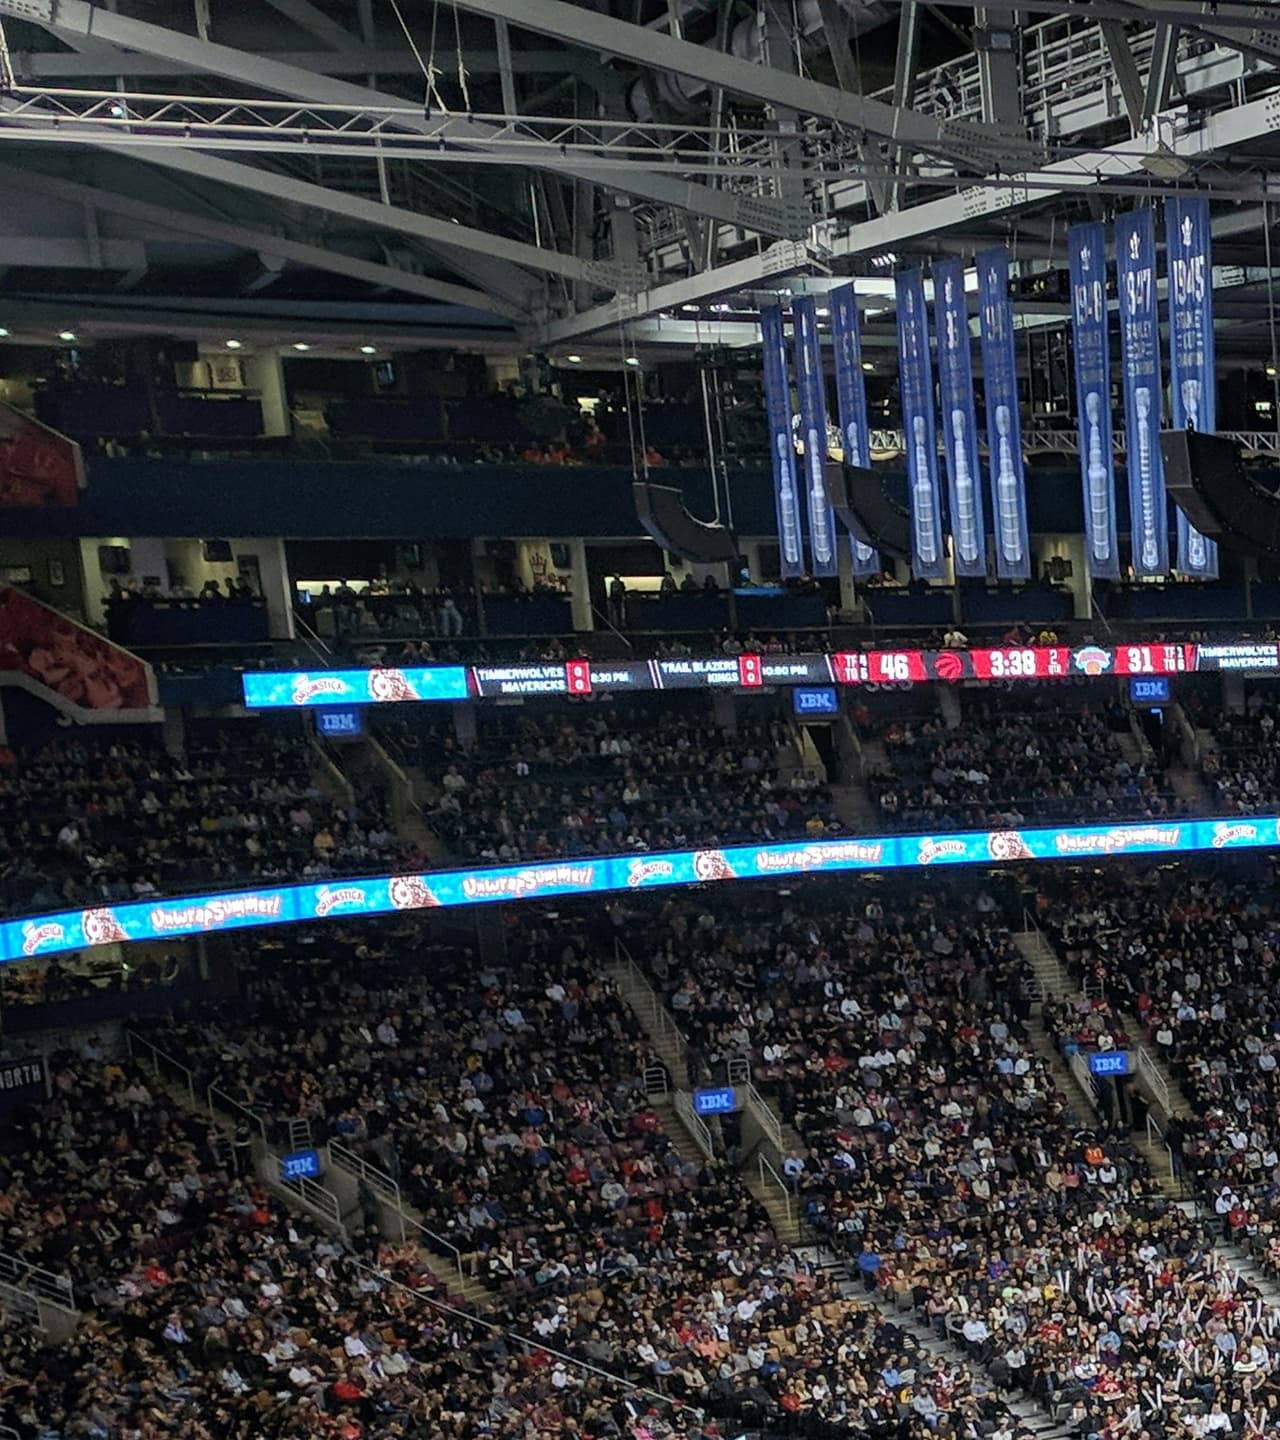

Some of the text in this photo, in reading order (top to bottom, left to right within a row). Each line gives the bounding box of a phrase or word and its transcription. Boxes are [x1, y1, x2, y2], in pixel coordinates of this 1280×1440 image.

[1049, 649, 1058, 662] 2
[1163, 646, 1175, 658] TF
[661, 660, 738, 673] TRAIL BLAZERS
[845, 654, 858, 667] TF
[880, 653, 909, 680] 46
[990, 649, 1036, 677] 3:38
[1127, 646, 1154, 673] 31
[478, 667, 565, 681] TIMBERWOLVES
[613, 671, 630, 682] PM
[790, 664, 808, 676] PM
[707, 672, 739, 683] KINGS
[501, 681, 566, 693] MAVERICKS
[1135, 682, 1165, 697] IBM
[799, 693, 832, 708] IBM
[321, 714, 356, 729] IBM
[1094, 1055, 1122, 1072] IBM
[699, 1093, 729, 1110] IBM
[287, 1157, 314, 1174] IBM
